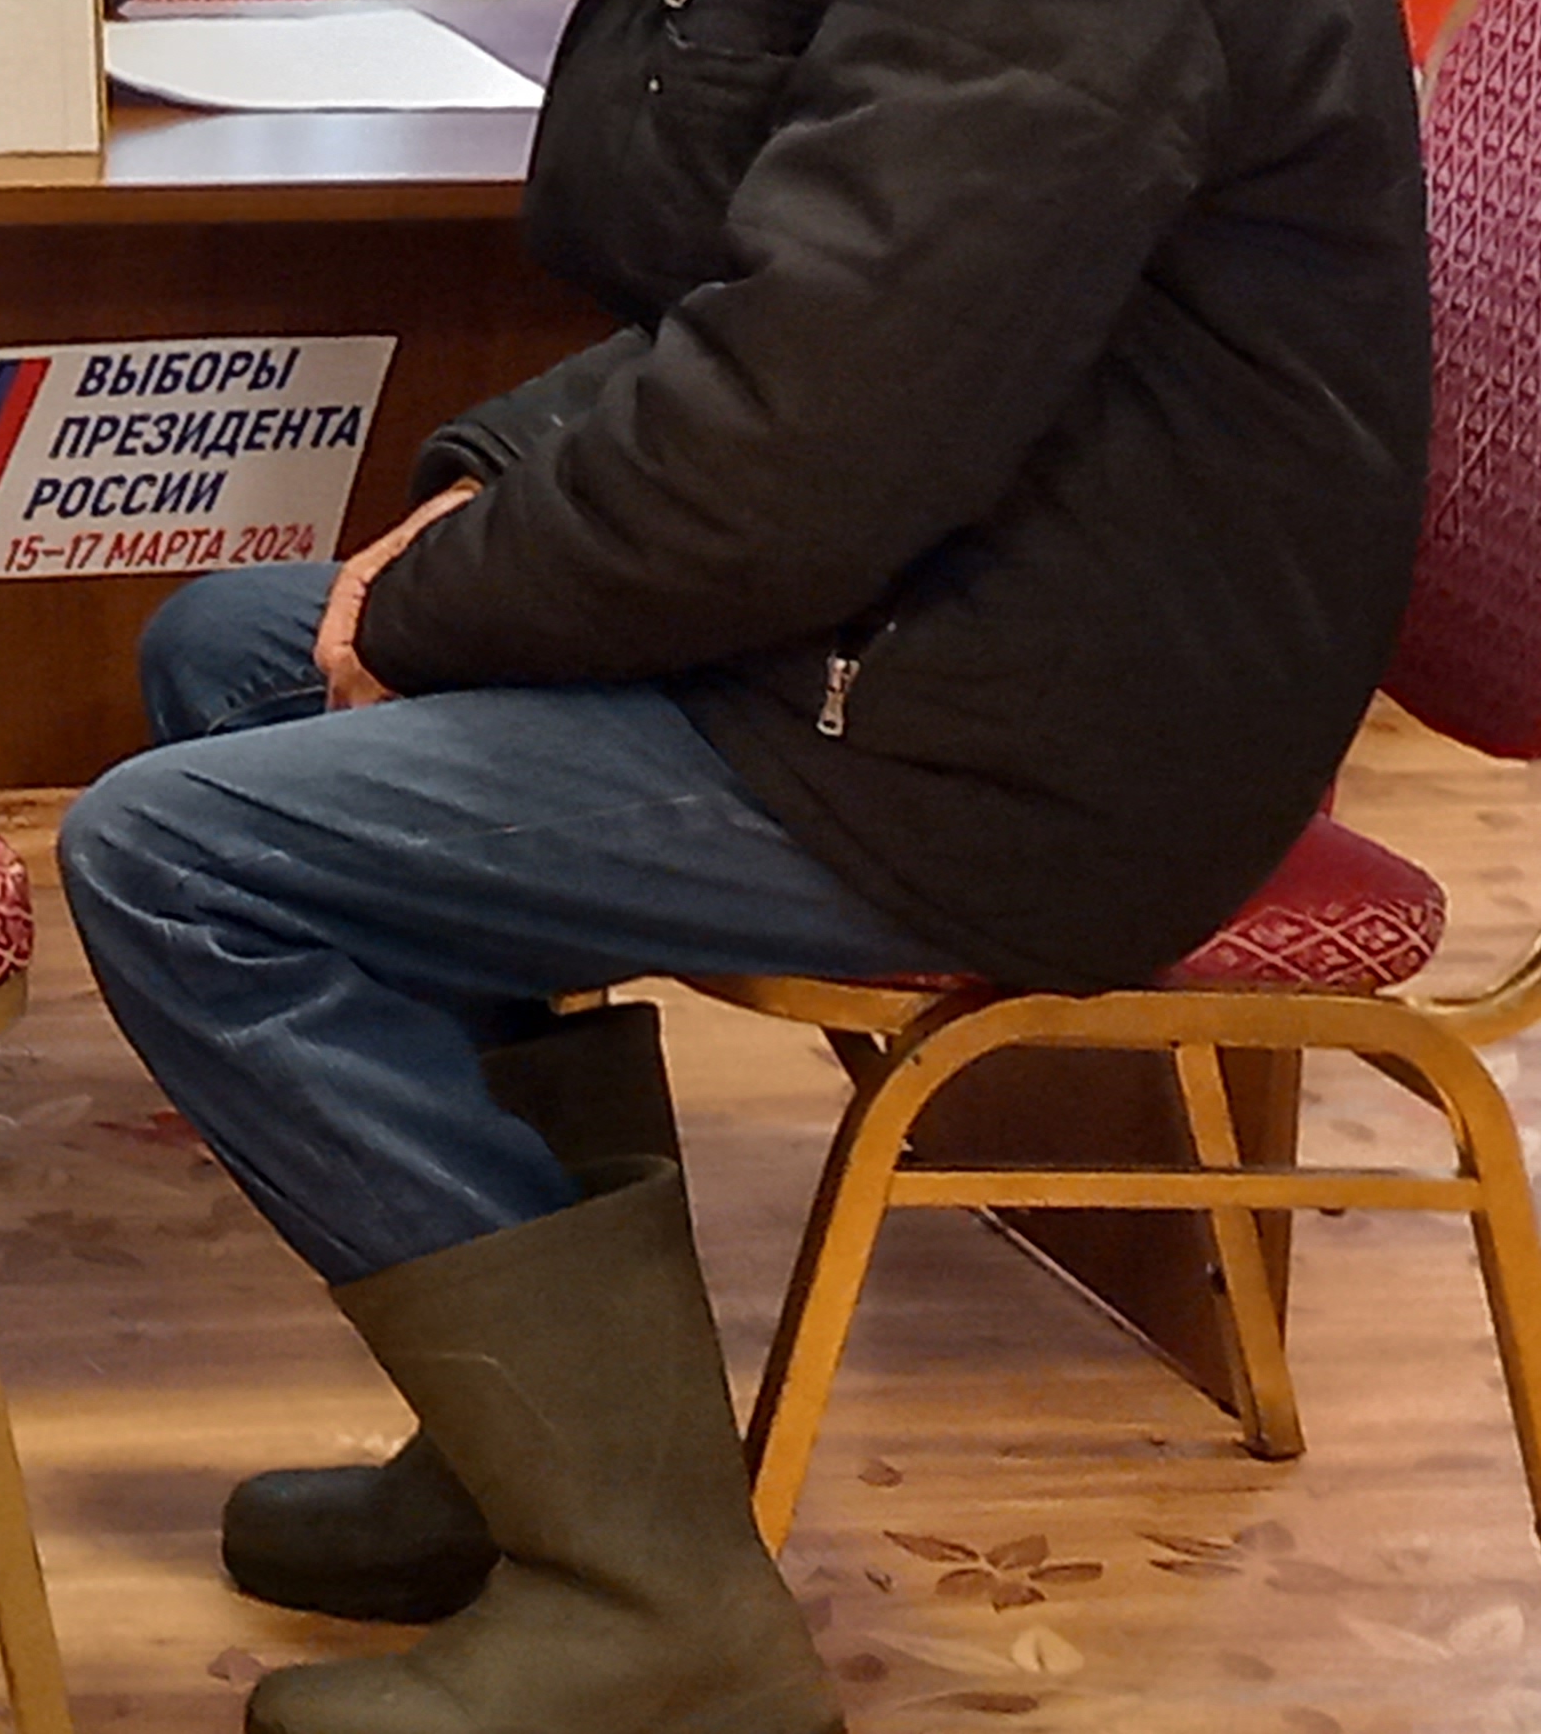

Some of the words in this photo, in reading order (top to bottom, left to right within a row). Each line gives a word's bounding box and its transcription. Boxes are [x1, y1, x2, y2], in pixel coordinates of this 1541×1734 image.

[75, 347, 301, 398] ВЫБОРЫ
[48, 405, 363, 460] ПРЕЗИДЕНТА
[22, 470, 229, 520] РОССИИ
[104, 526, 227, 569] МАРТА
[228, 522, 317, 565] 2024
